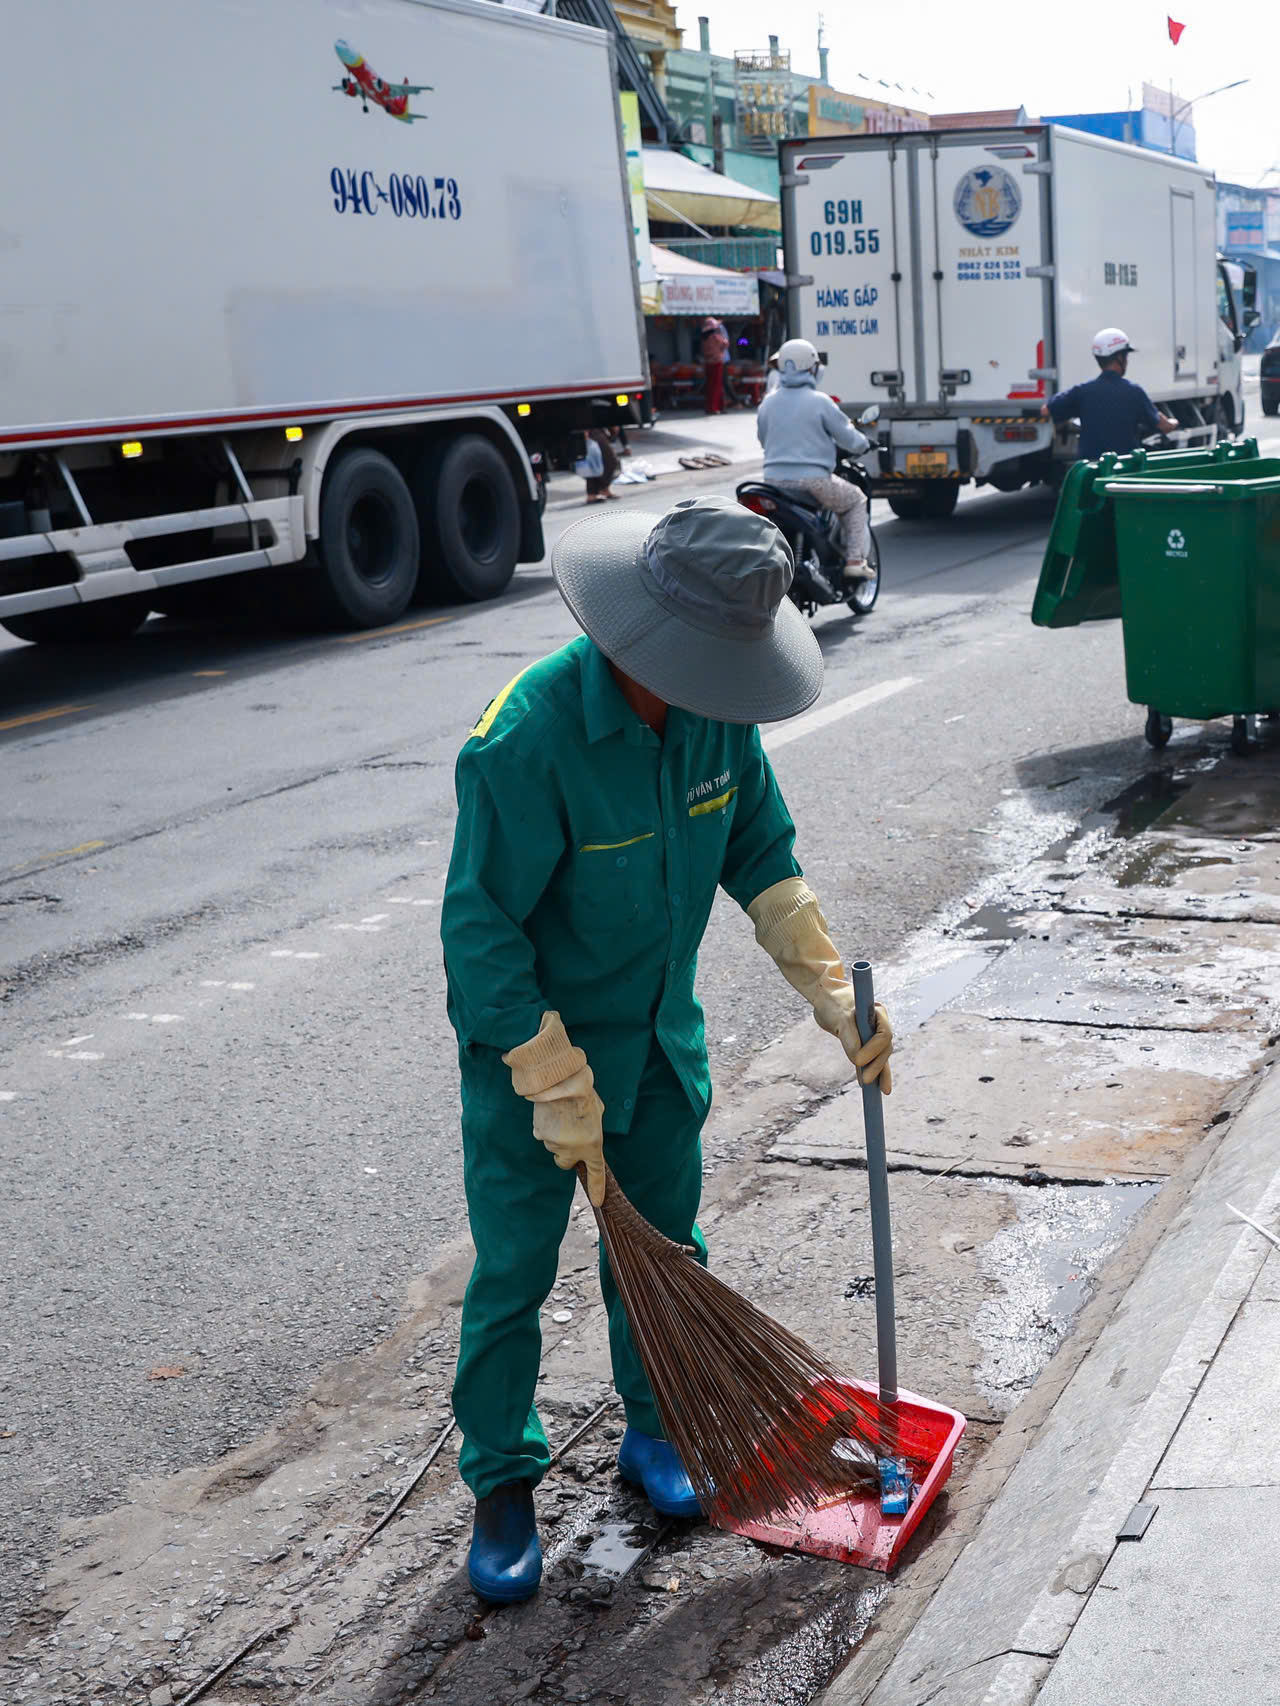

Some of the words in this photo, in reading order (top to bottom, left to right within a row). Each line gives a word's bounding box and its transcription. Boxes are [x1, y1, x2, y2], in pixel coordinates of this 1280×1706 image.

[330, 167, 462, 220] 94C-080.73
[824, 199, 863, 224] 69H
[810, 229, 880, 256] 019.55
[996, 245, 1020, 257] KIM
[816, 284, 849, 308] HÀNG
[816, 319, 830, 336] XIN
[1165, 550, 1188, 558] RECYCLE
